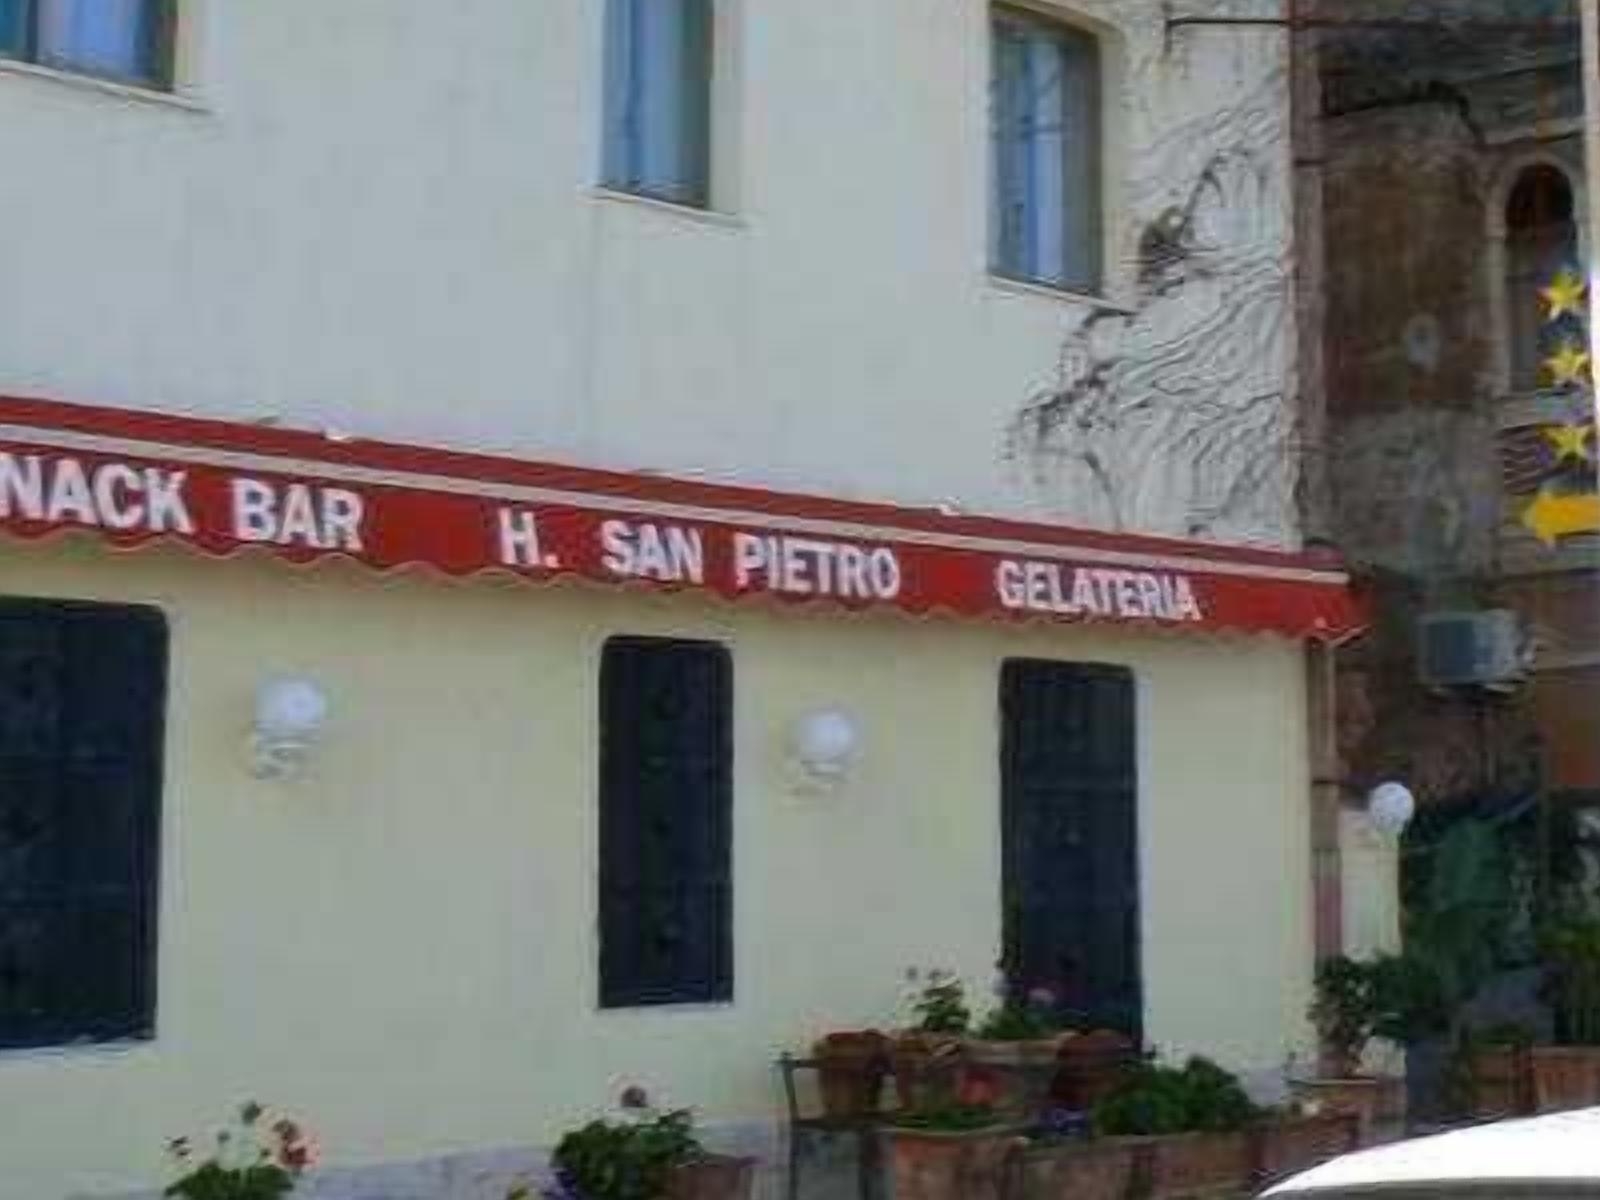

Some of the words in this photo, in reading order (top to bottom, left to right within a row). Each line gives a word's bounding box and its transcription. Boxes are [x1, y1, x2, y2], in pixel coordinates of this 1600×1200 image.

[0, 452, 195, 534] NACK
[229, 477, 364, 553] BAR
[498, 508, 559, 568] H.
[600, 519, 703, 584] SAN
[734, 532, 901, 599] PIETRO
[997, 560, 1202, 621] GELATERIA
